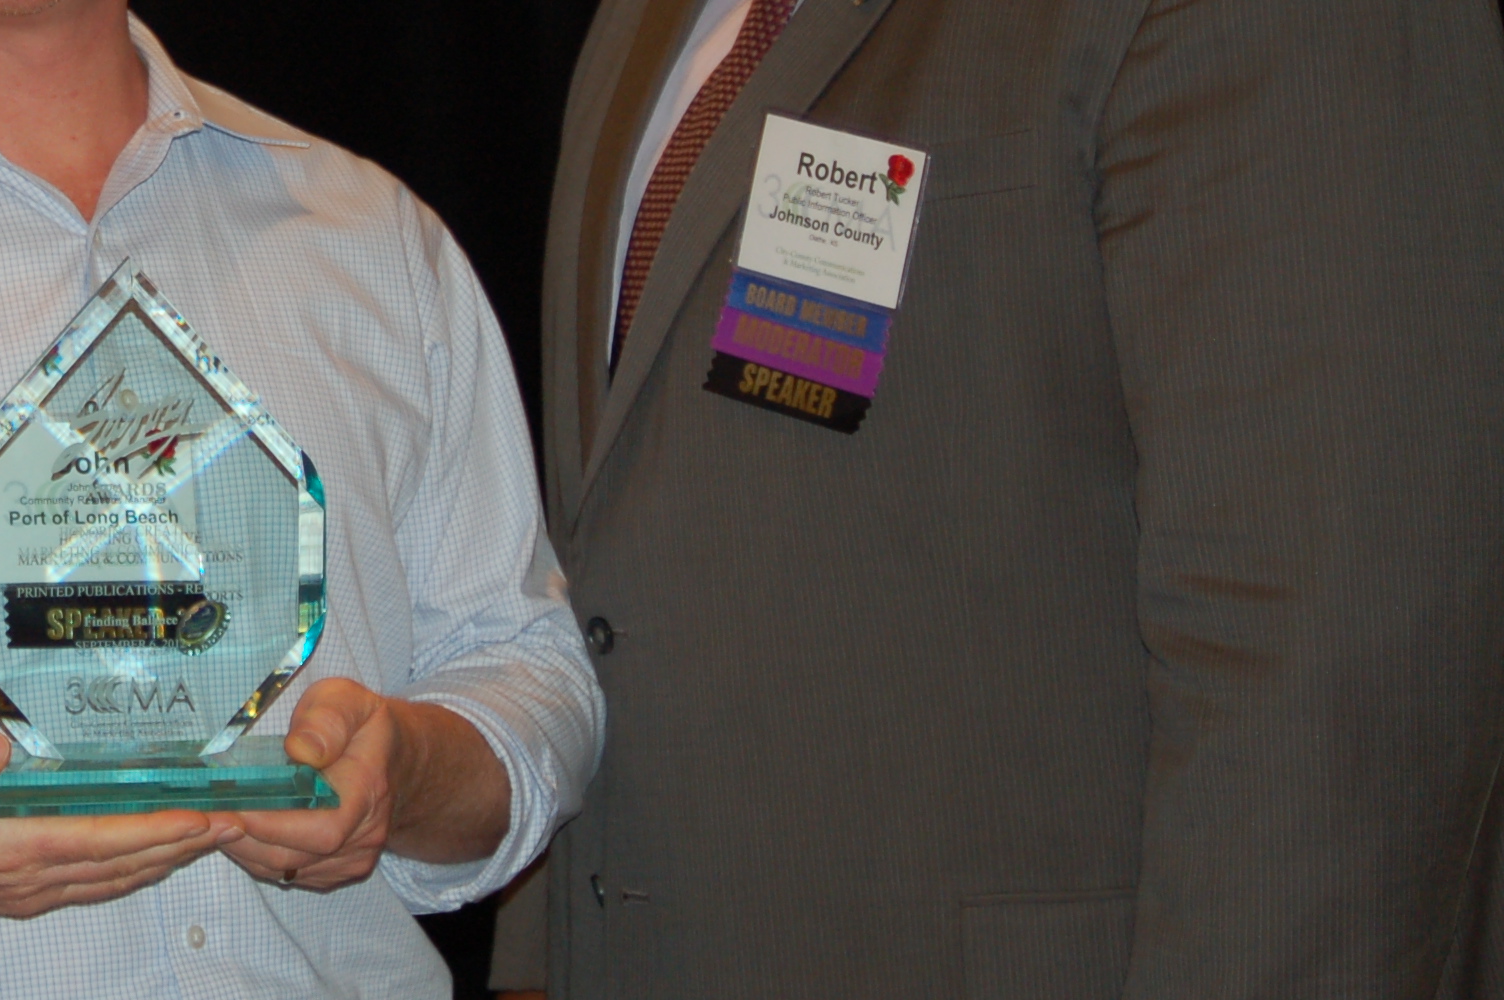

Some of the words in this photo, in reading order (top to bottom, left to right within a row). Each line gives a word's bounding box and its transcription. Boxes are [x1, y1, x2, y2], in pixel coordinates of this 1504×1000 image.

[797, 152, 877, 194] Robert
[805, 185, 832, 200] Robert
[808, 200, 851, 218] Information
[769, 205, 830, 233] Johnson
[834, 221, 884, 251] County
[746, 283, 796, 317] BOARD
[799, 299, 868, 338] MEMBER
[733, 313, 866, 380] MODERATOR
[739, 363, 838, 419] SPEAKER
[20, 496, 75, 508] Community
[9, 510, 46, 526] Port
[52, 509, 70, 525] of
[75, 510, 119, 529] Long
[125, 509, 179, 525] Beach
[17, 585, 75, 599] PRINTED
[77, 583, 174, 597] PUBLICATIONS
[47, 607, 165, 641] SPEAKER
[84, 615, 129, 629] Finding
[132, 614, 178, 627] Balance
[75, 639, 147, 651] SEPTEMBER
